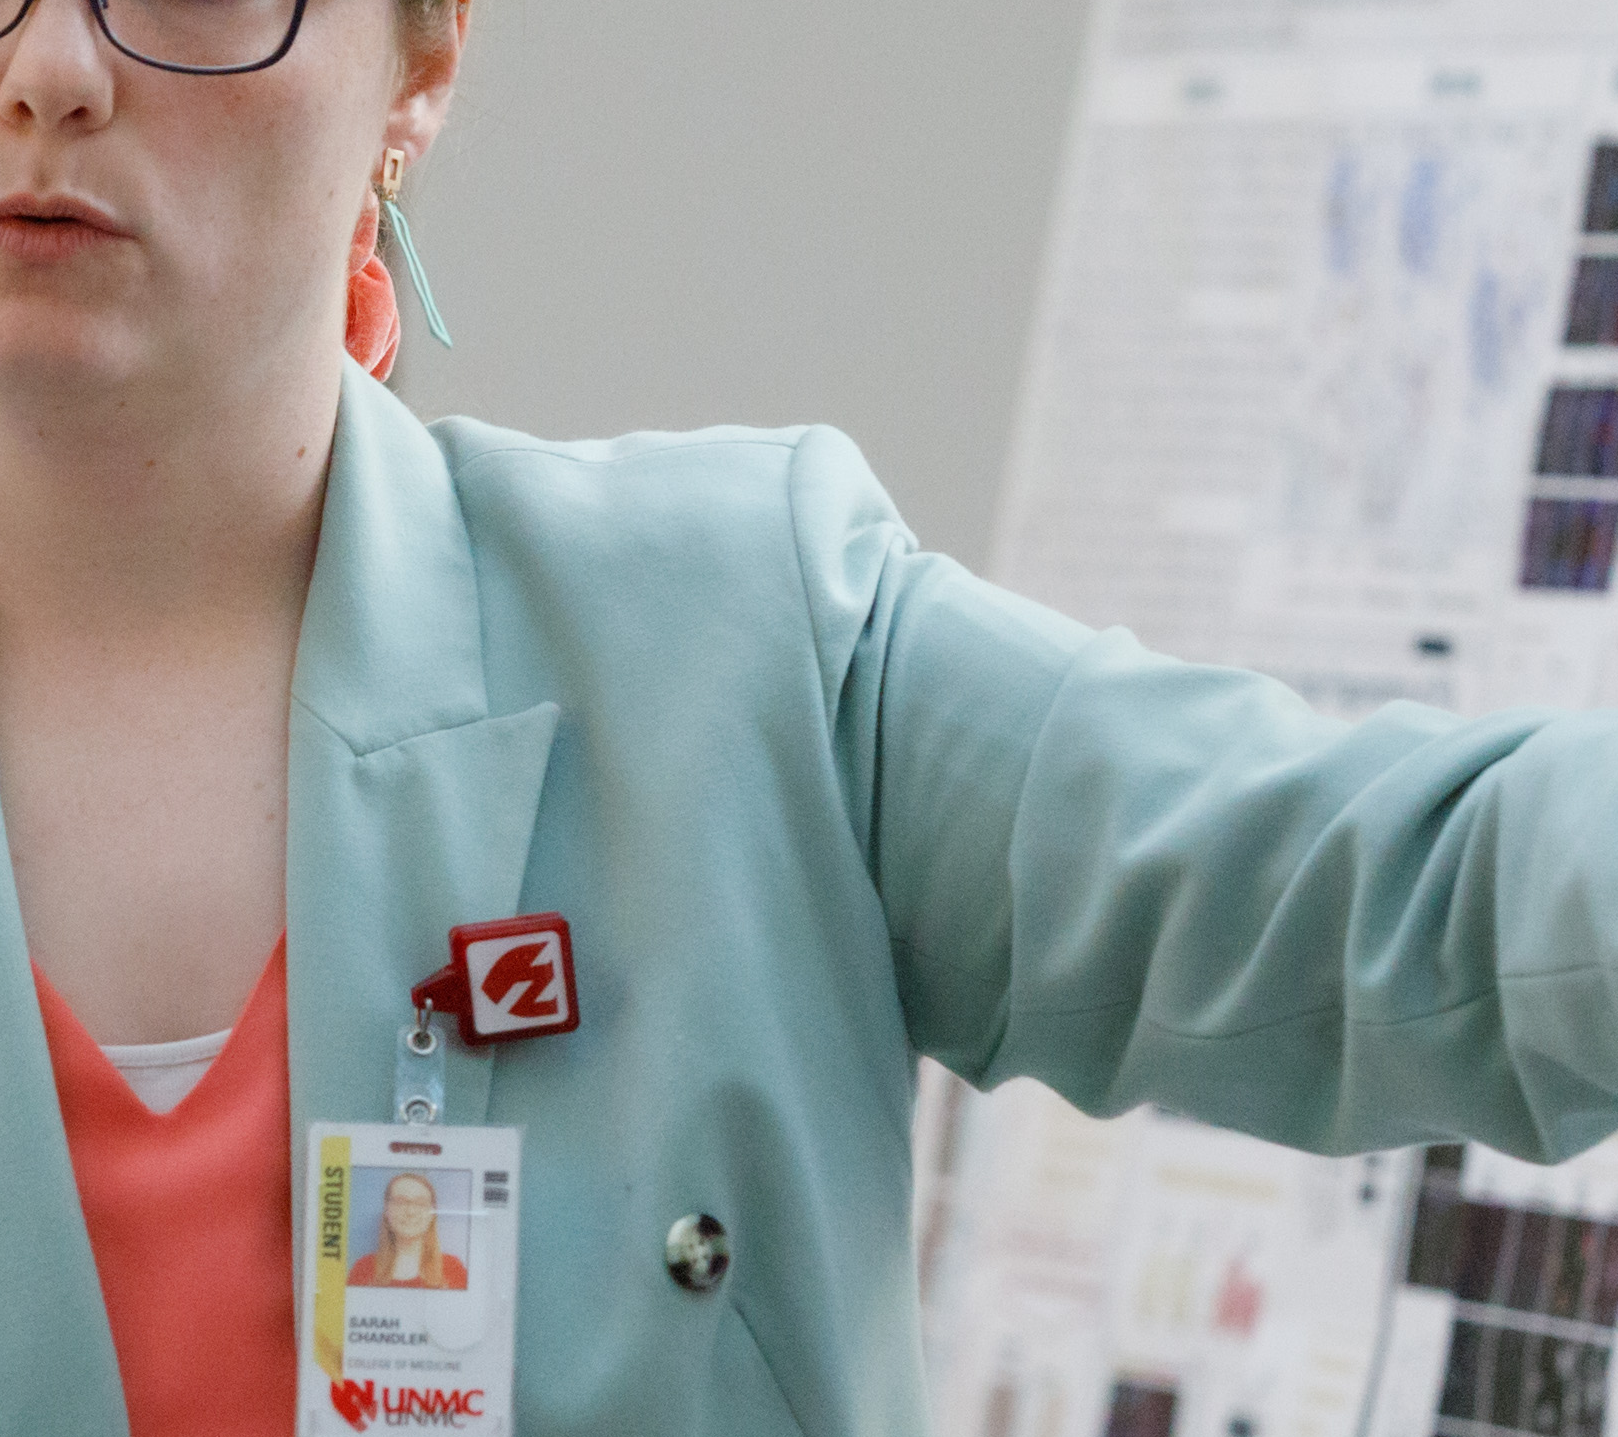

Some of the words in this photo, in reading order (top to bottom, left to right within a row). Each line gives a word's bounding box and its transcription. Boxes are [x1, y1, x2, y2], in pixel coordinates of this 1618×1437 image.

[321, 1166, 344, 1261] STUDENT
[348, 1316, 401, 1330] SARAH
[347, 1331, 429, 1346] CHANDLER
[382, 1387, 485, 1417] UNMC
